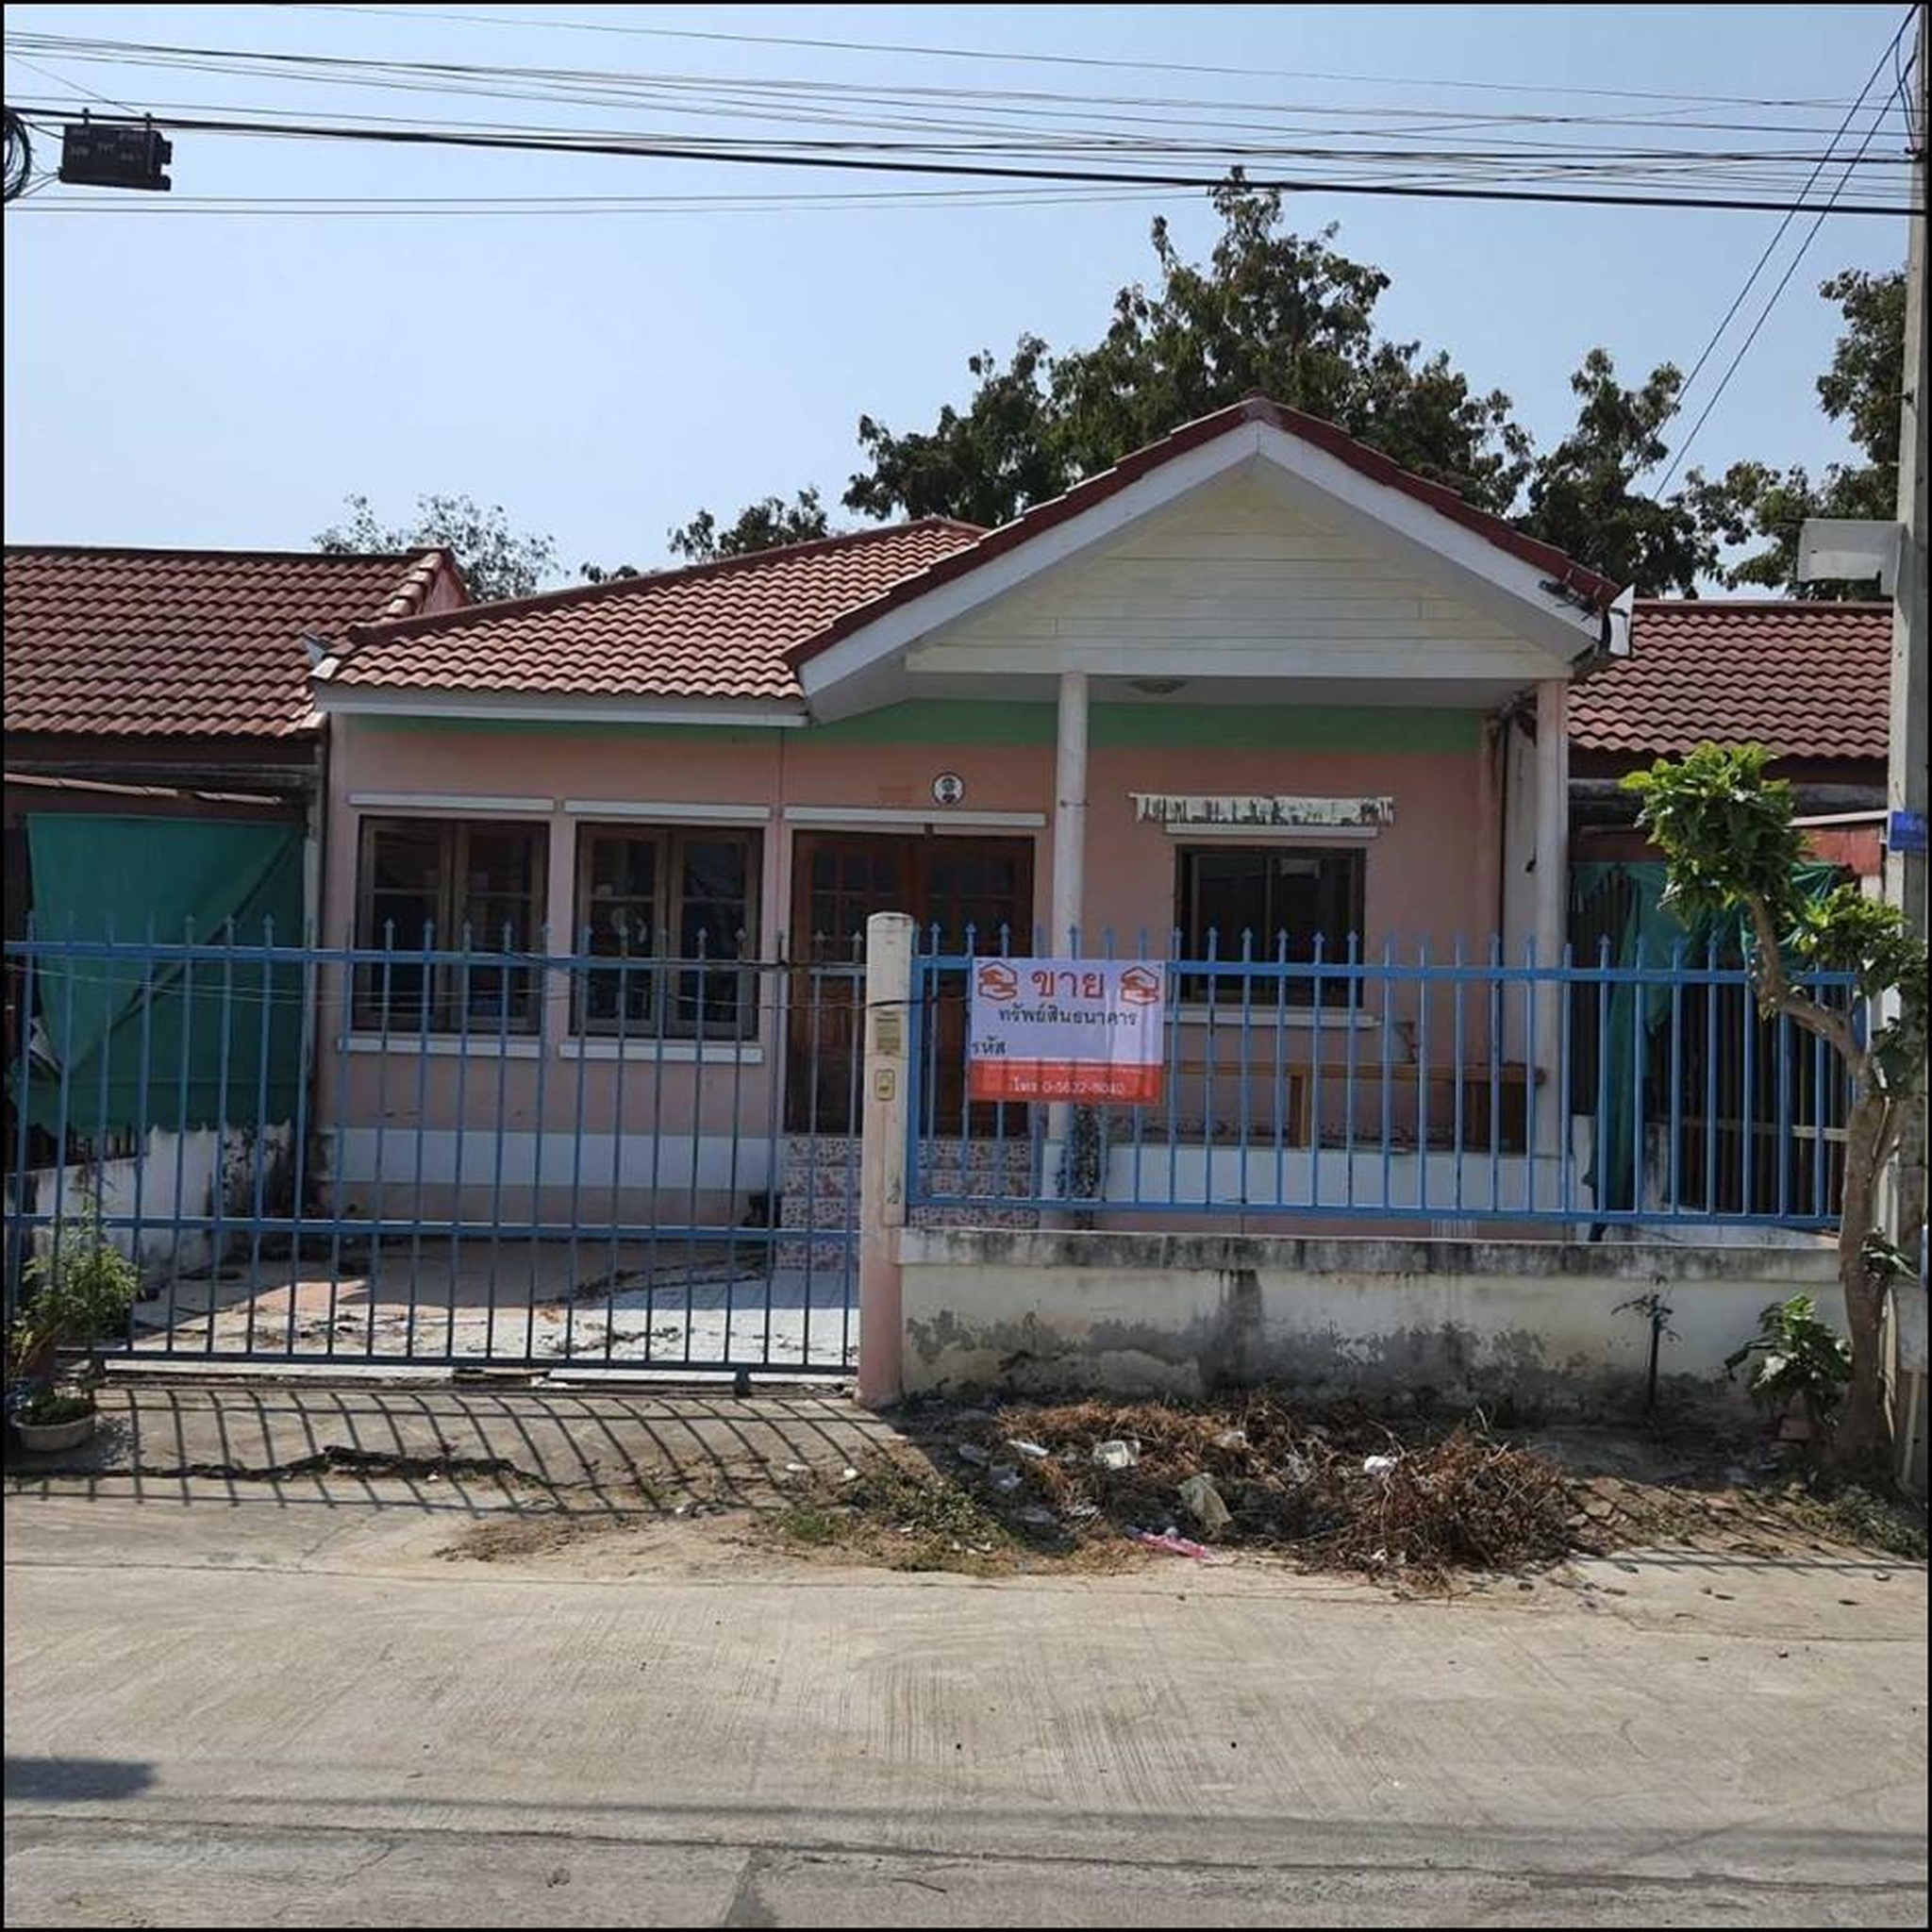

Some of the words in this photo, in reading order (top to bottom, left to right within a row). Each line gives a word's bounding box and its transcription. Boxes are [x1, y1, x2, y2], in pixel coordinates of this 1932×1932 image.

[1031, 970, 1104, 998] ขาย
[998, 1003, 1138, 1025] ทรัพย์สินธนาคาร
[972, 1035, 1007, 1055] รหัส
